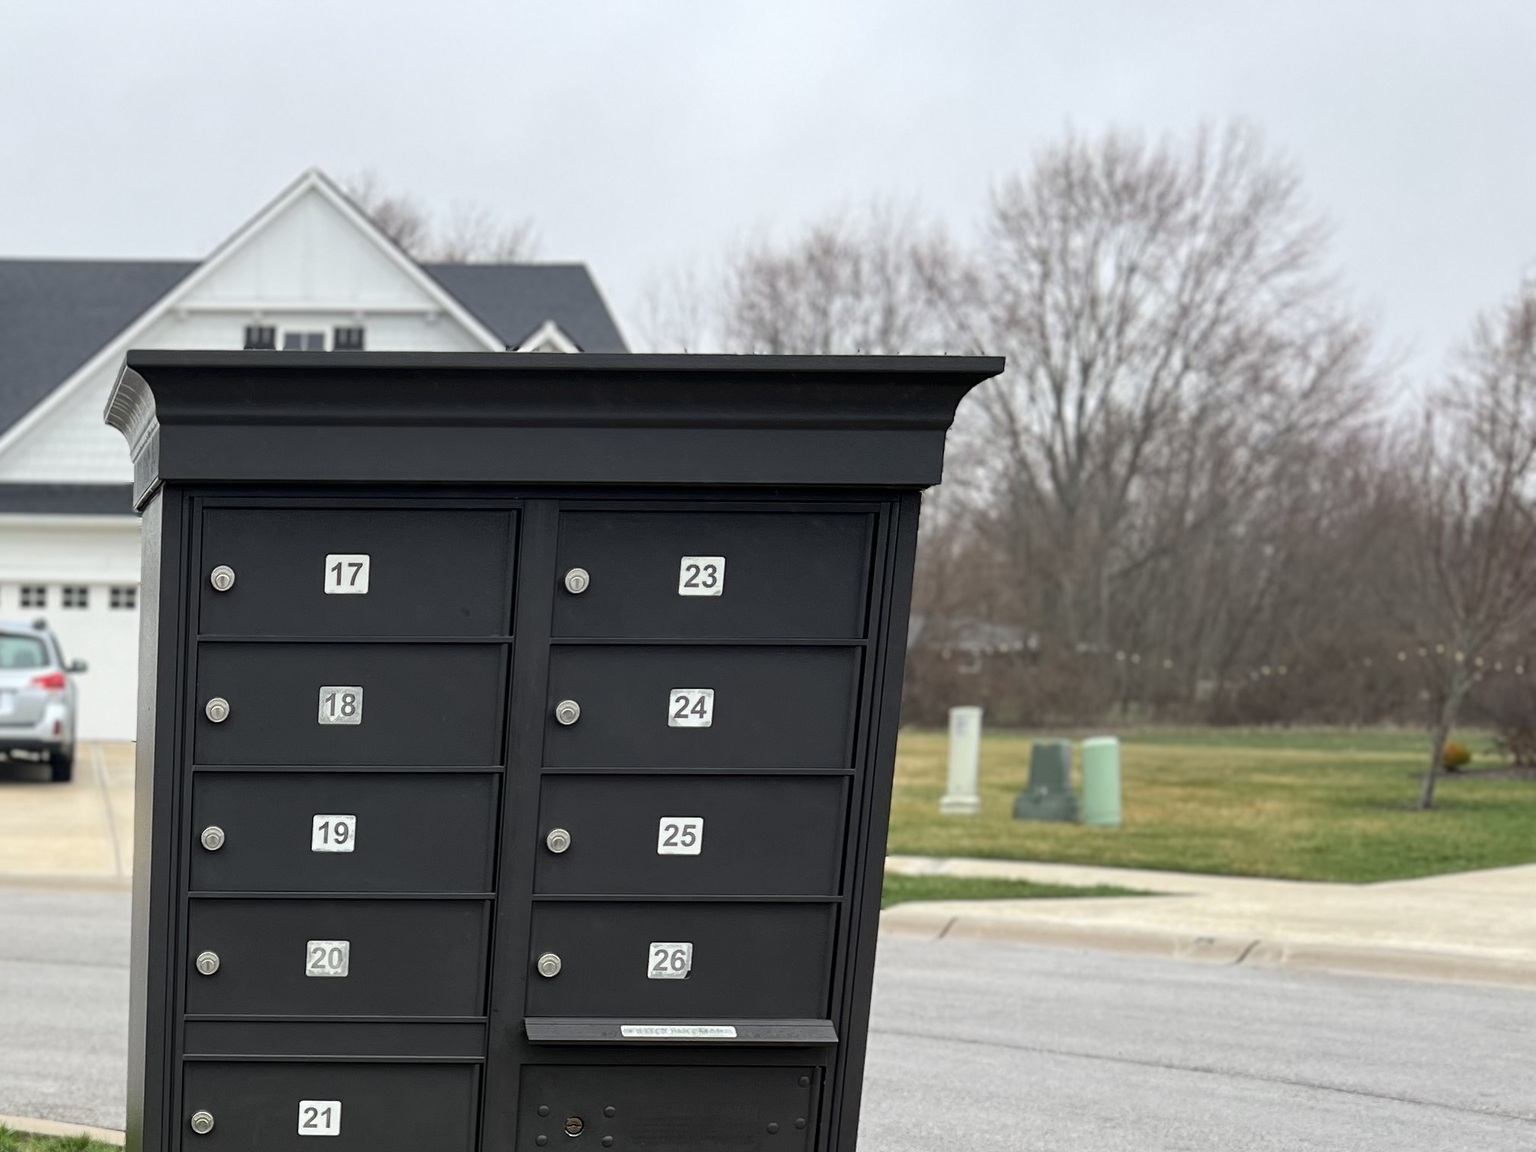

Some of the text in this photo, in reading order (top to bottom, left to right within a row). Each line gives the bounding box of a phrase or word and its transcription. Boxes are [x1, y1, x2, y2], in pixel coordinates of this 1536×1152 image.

[331, 562, 363, 586] 17
[684, 564, 717, 588] 23
[325, 693, 356, 716] 18
[674, 696, 707, 719] 24
[318, 821, 349, 844] 19
[663, 824, 696, 846] 25
[310, 947, 343, 969] 20
[653, 949, 686, 971] 26
[304, 1107, 331, 1128] 21
